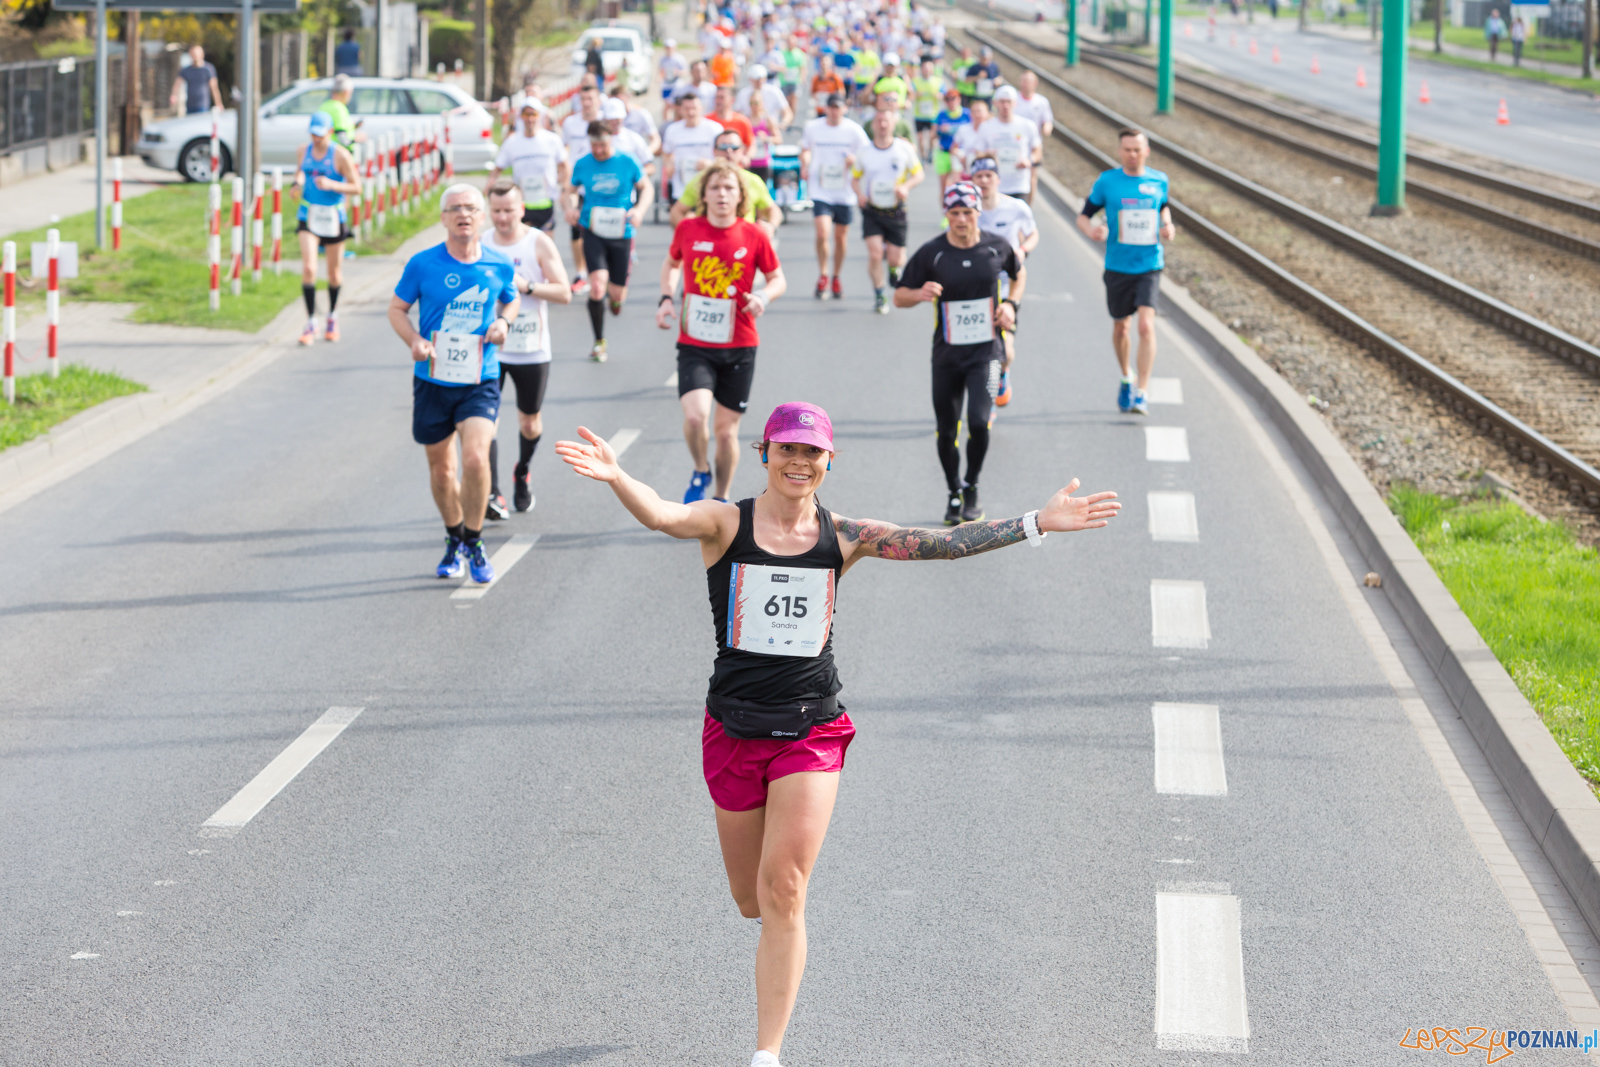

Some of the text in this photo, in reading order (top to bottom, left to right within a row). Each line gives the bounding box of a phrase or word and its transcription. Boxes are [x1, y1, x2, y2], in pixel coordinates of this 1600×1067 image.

[450, 300, 482, 312] BIKE
[695, 309, 725, 324] 7287
[955, 313, 986, 326] 7692
[447, 348, 468, 361] 129
[764, 595, 807, 618] 615
[771, 621, 797, 630] Sandra
